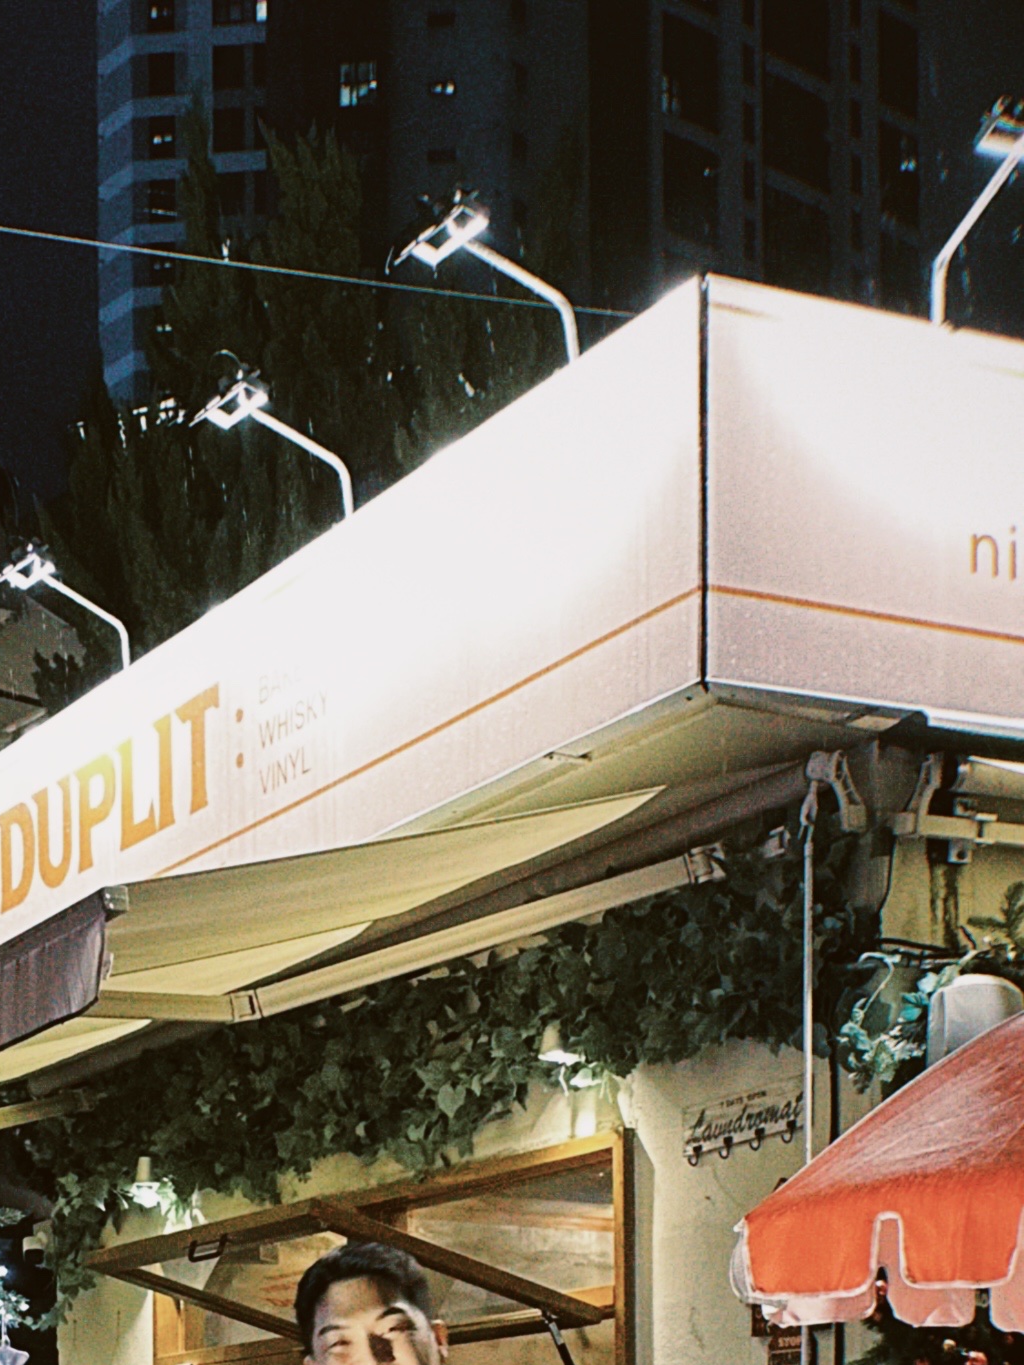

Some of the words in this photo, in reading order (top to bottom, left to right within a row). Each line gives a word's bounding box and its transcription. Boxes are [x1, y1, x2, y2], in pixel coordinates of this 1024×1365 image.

[258, 688, 328, 749] WHISKY
[258, 746, 312, 795] VINYL
[685, 1091, 804, 1144] Laundromat
